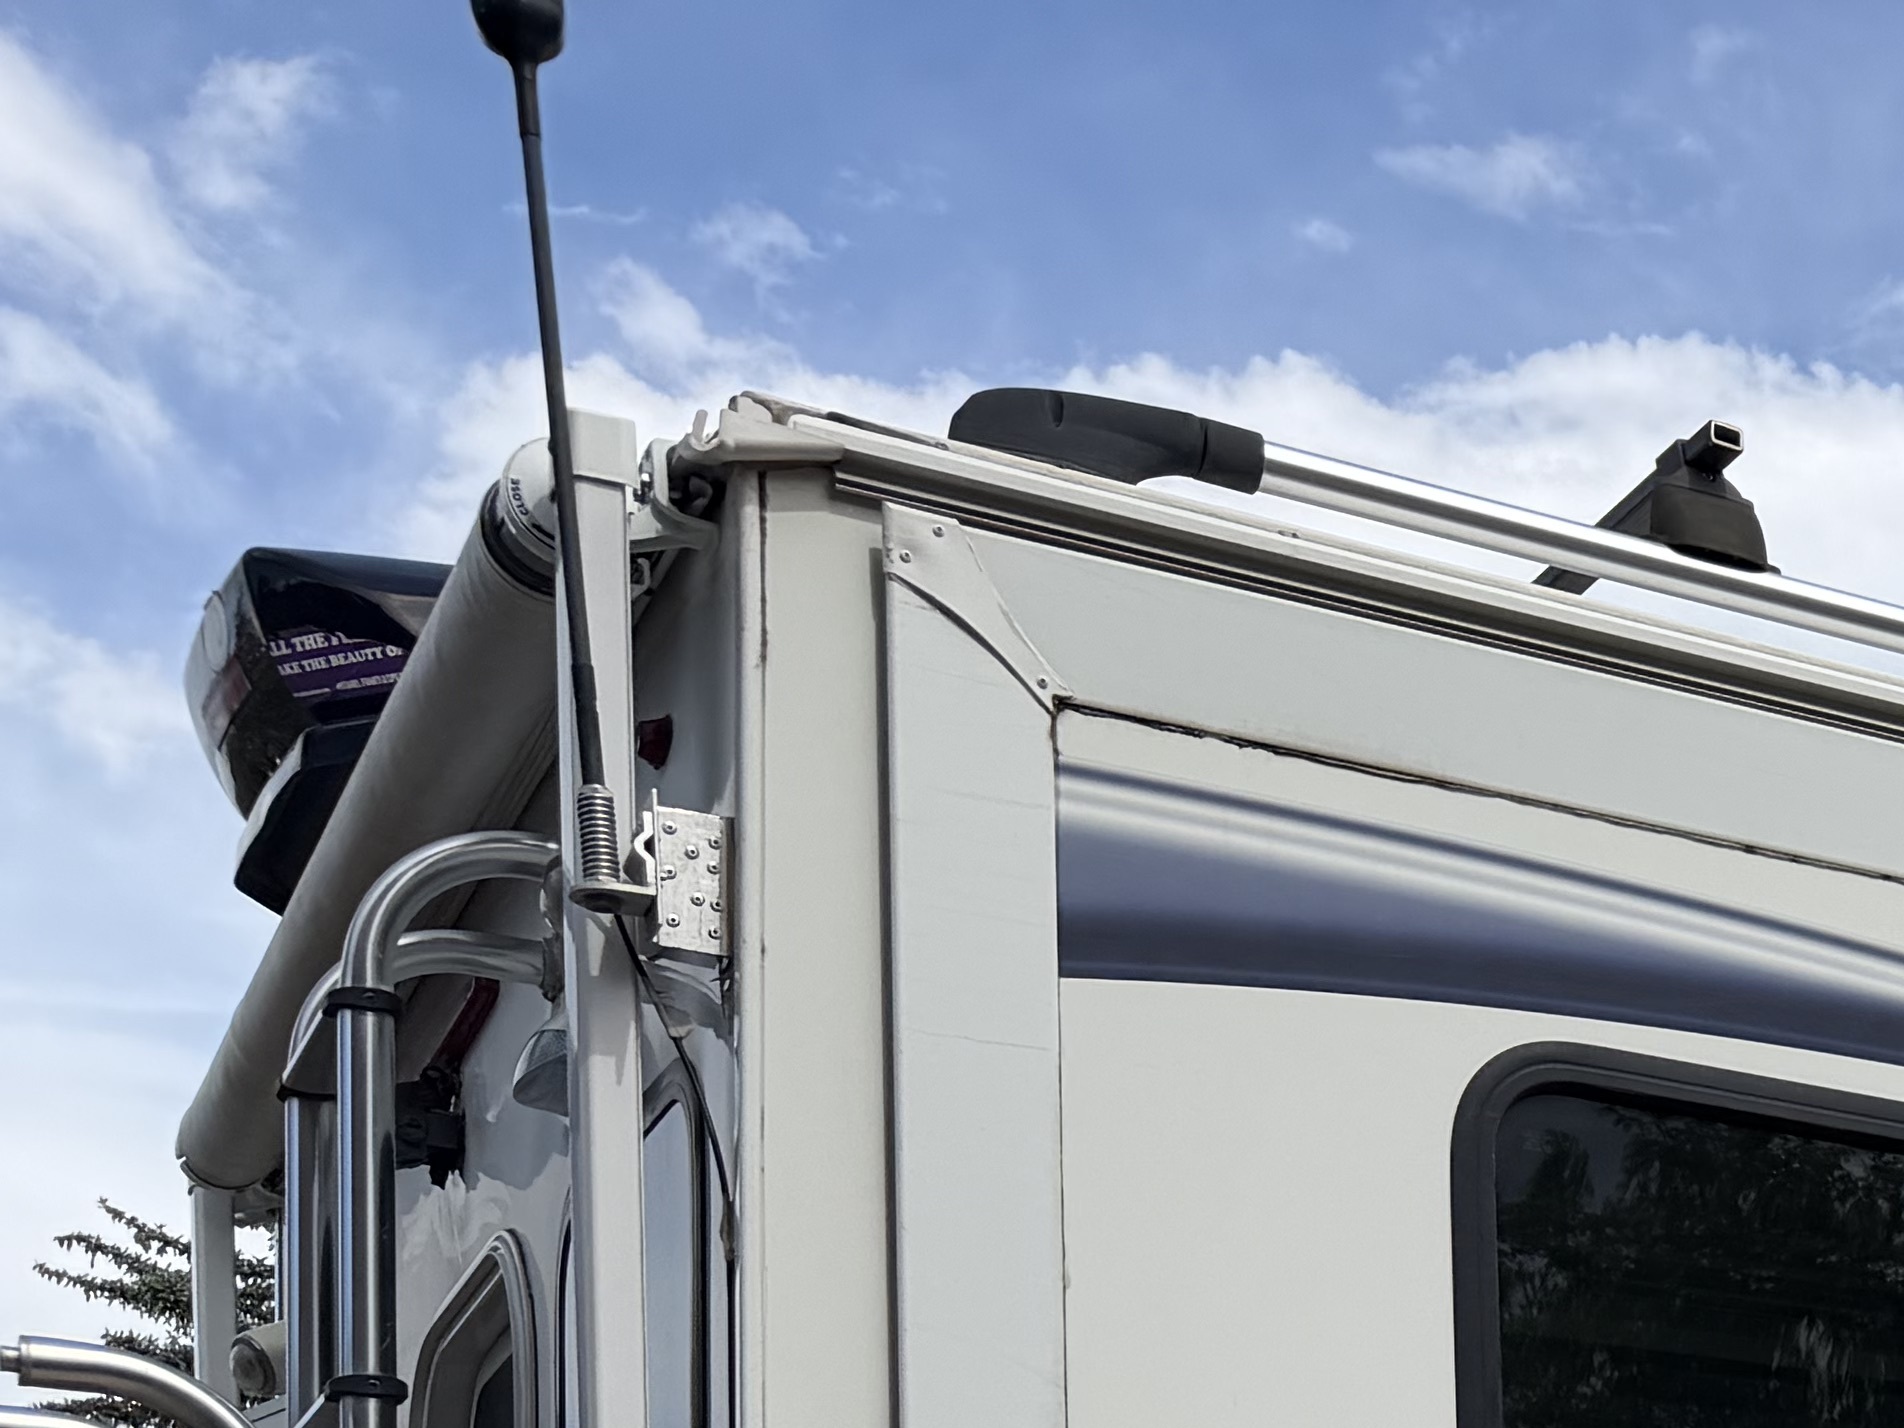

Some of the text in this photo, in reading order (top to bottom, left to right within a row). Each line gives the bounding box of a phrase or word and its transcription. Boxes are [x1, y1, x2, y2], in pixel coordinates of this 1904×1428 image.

[291, 632, 328, 652] THE
[301, 656, 330, 672] THE
[328, 646, 384, 667] BEAUTY
